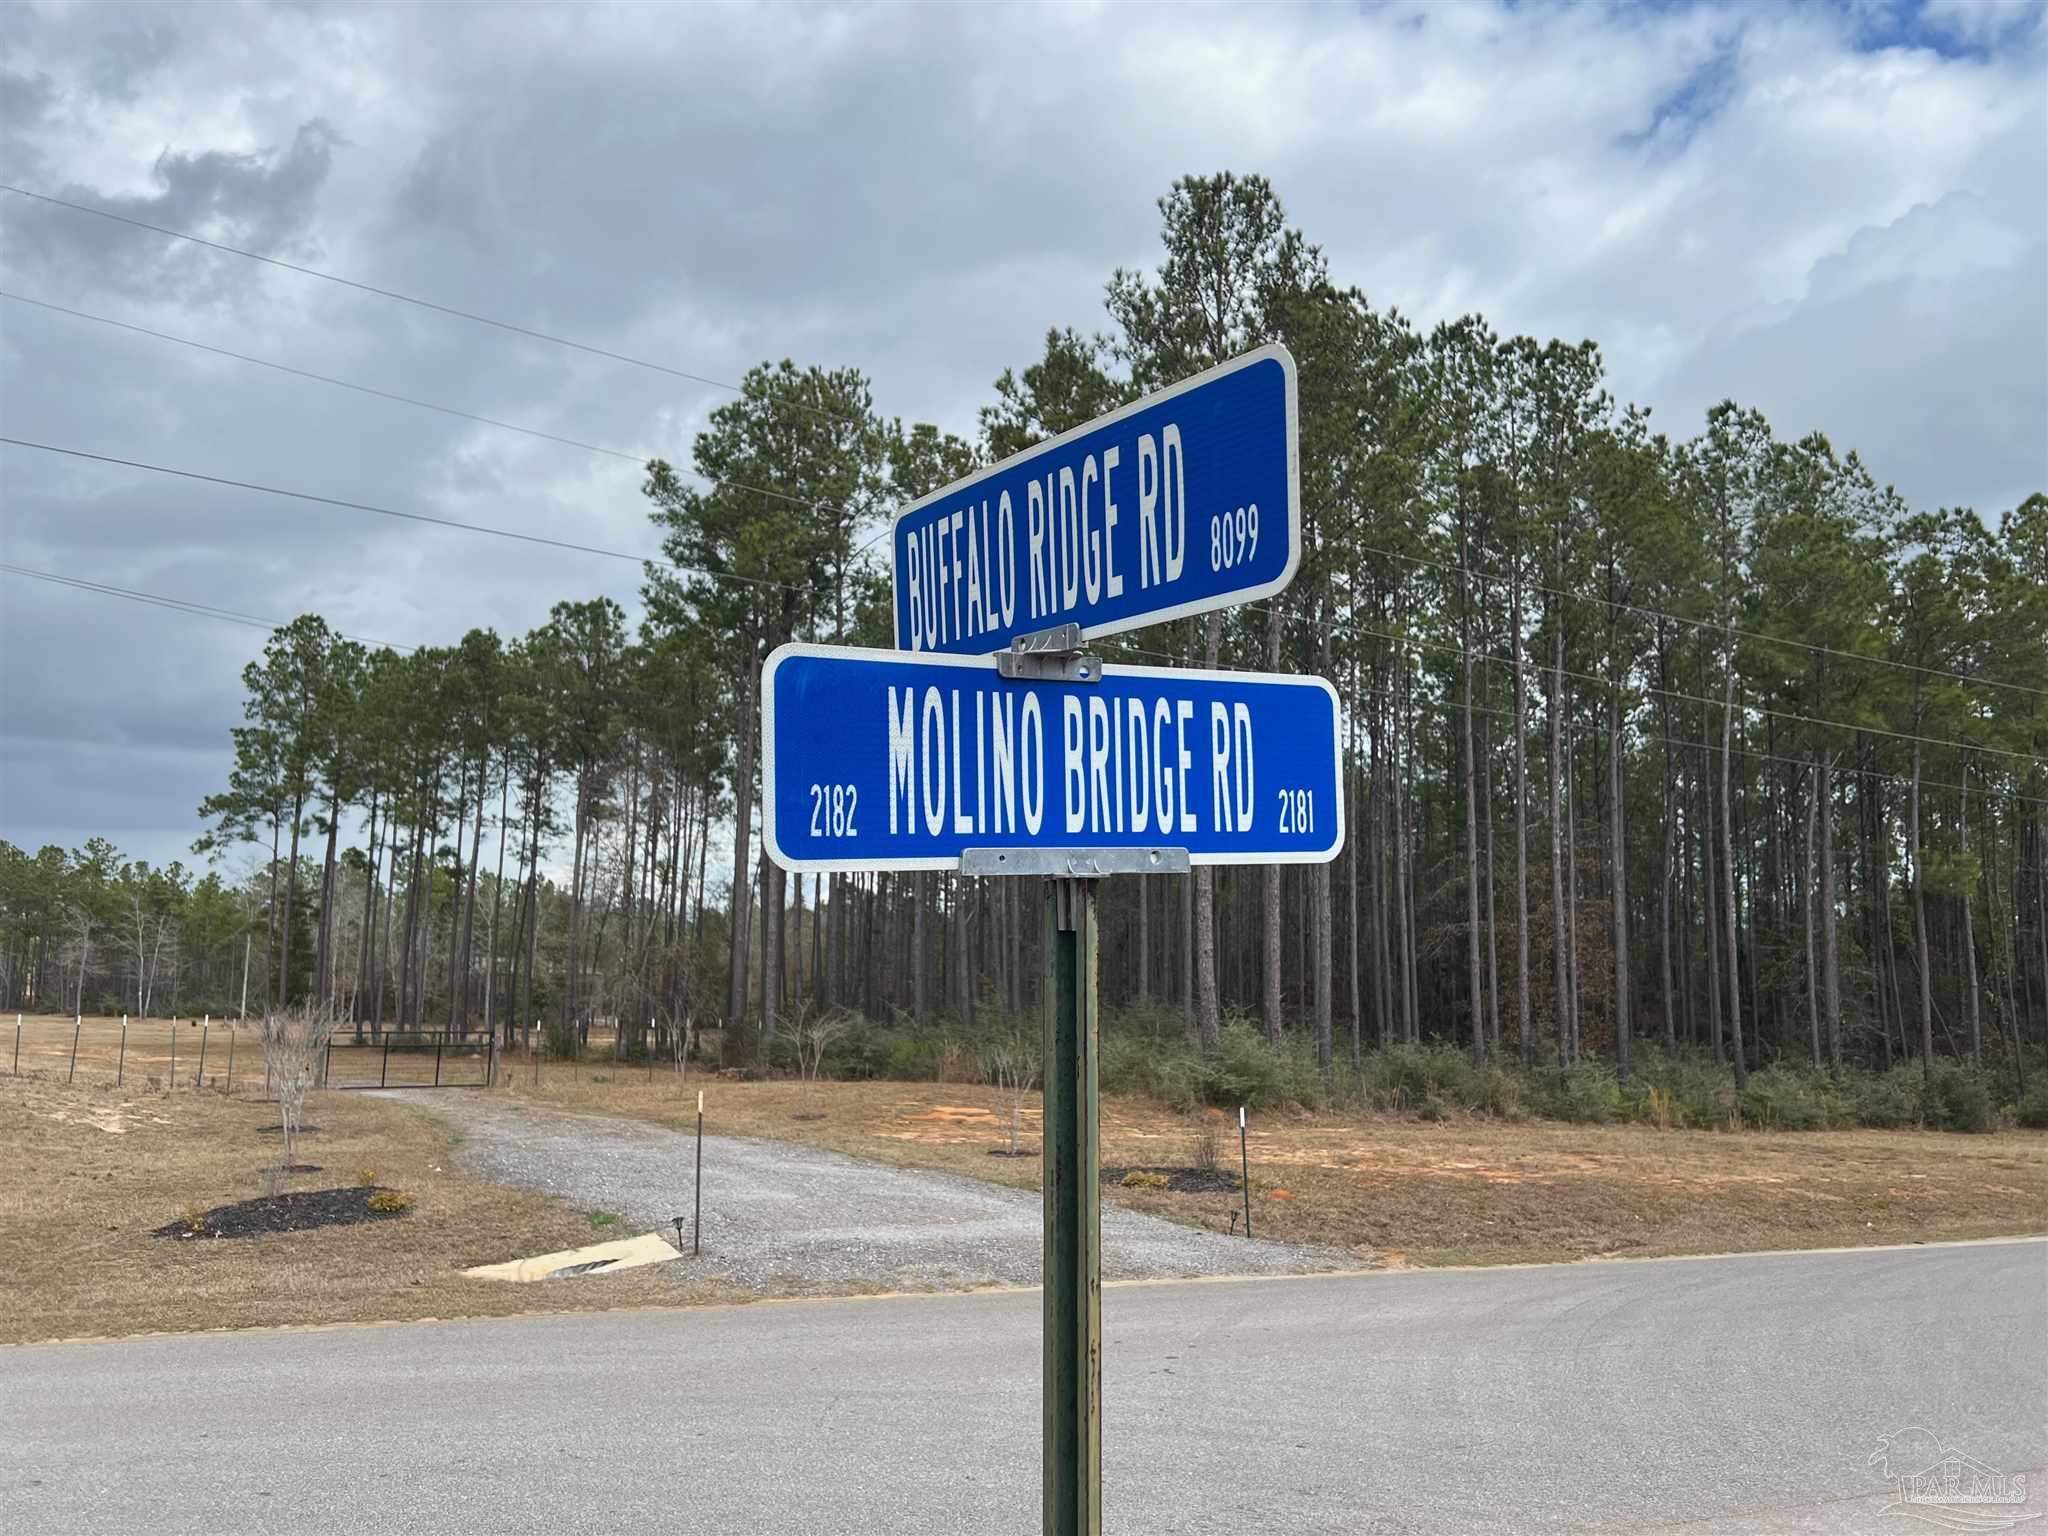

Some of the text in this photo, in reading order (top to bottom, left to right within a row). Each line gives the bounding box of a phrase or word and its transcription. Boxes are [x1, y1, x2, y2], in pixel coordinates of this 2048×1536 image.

[906, 422, 1185, 653] BUFFALO RIDGE RD
[1211, 503, 1259, 572] 8099
[888, 686, 1254, 836] MOLINO BRIDGE RD
[810, 783, 858, 837] 2182
[1278, 789, 1314, 834] 2181
